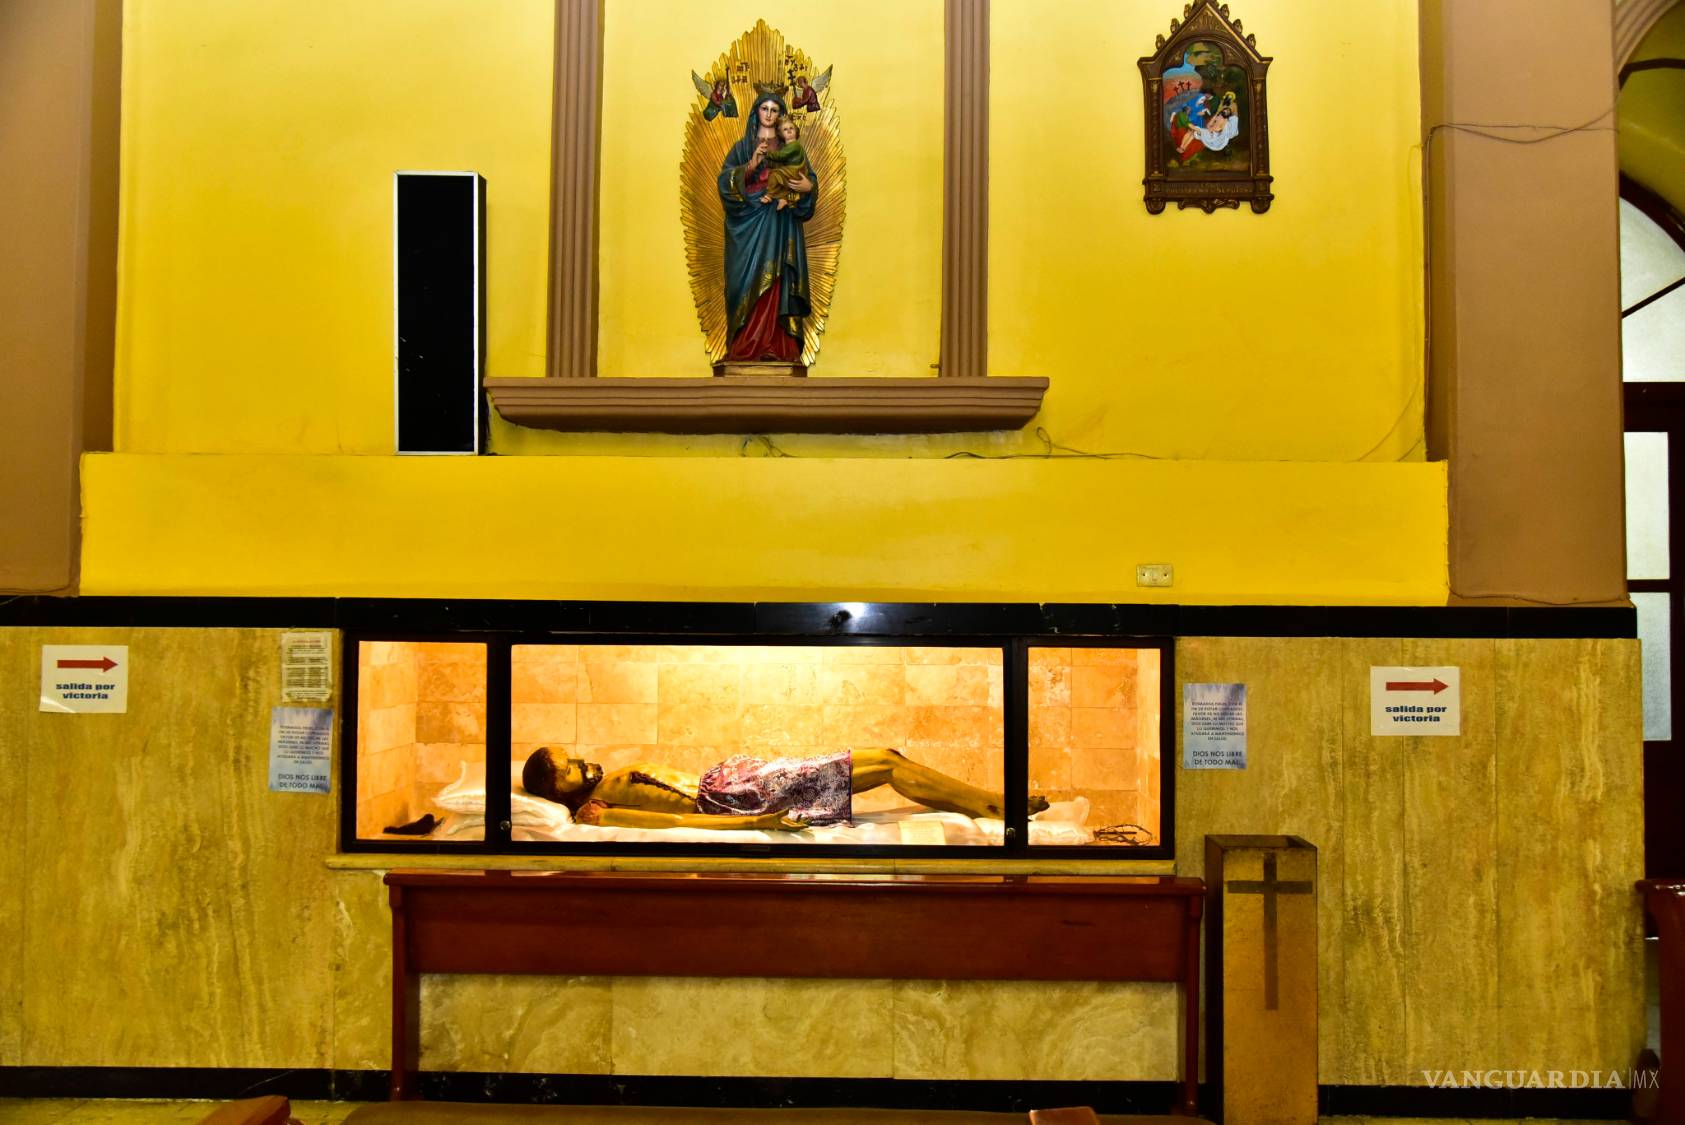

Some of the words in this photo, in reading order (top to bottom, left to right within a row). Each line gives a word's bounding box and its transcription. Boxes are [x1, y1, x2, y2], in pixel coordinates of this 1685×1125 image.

[56, 682, 92, 690] salida
[95, 683, 115, 691] por
[1385, 705, 1424, 713] salida
[1426, 706, 1447, 714] por
[1192, 750, 1208, 758] DIOS
[1209, 750, 1225, 758] NOS
[279, 781, 288, 789] DE
[289, 781, 308, 789] TODO
